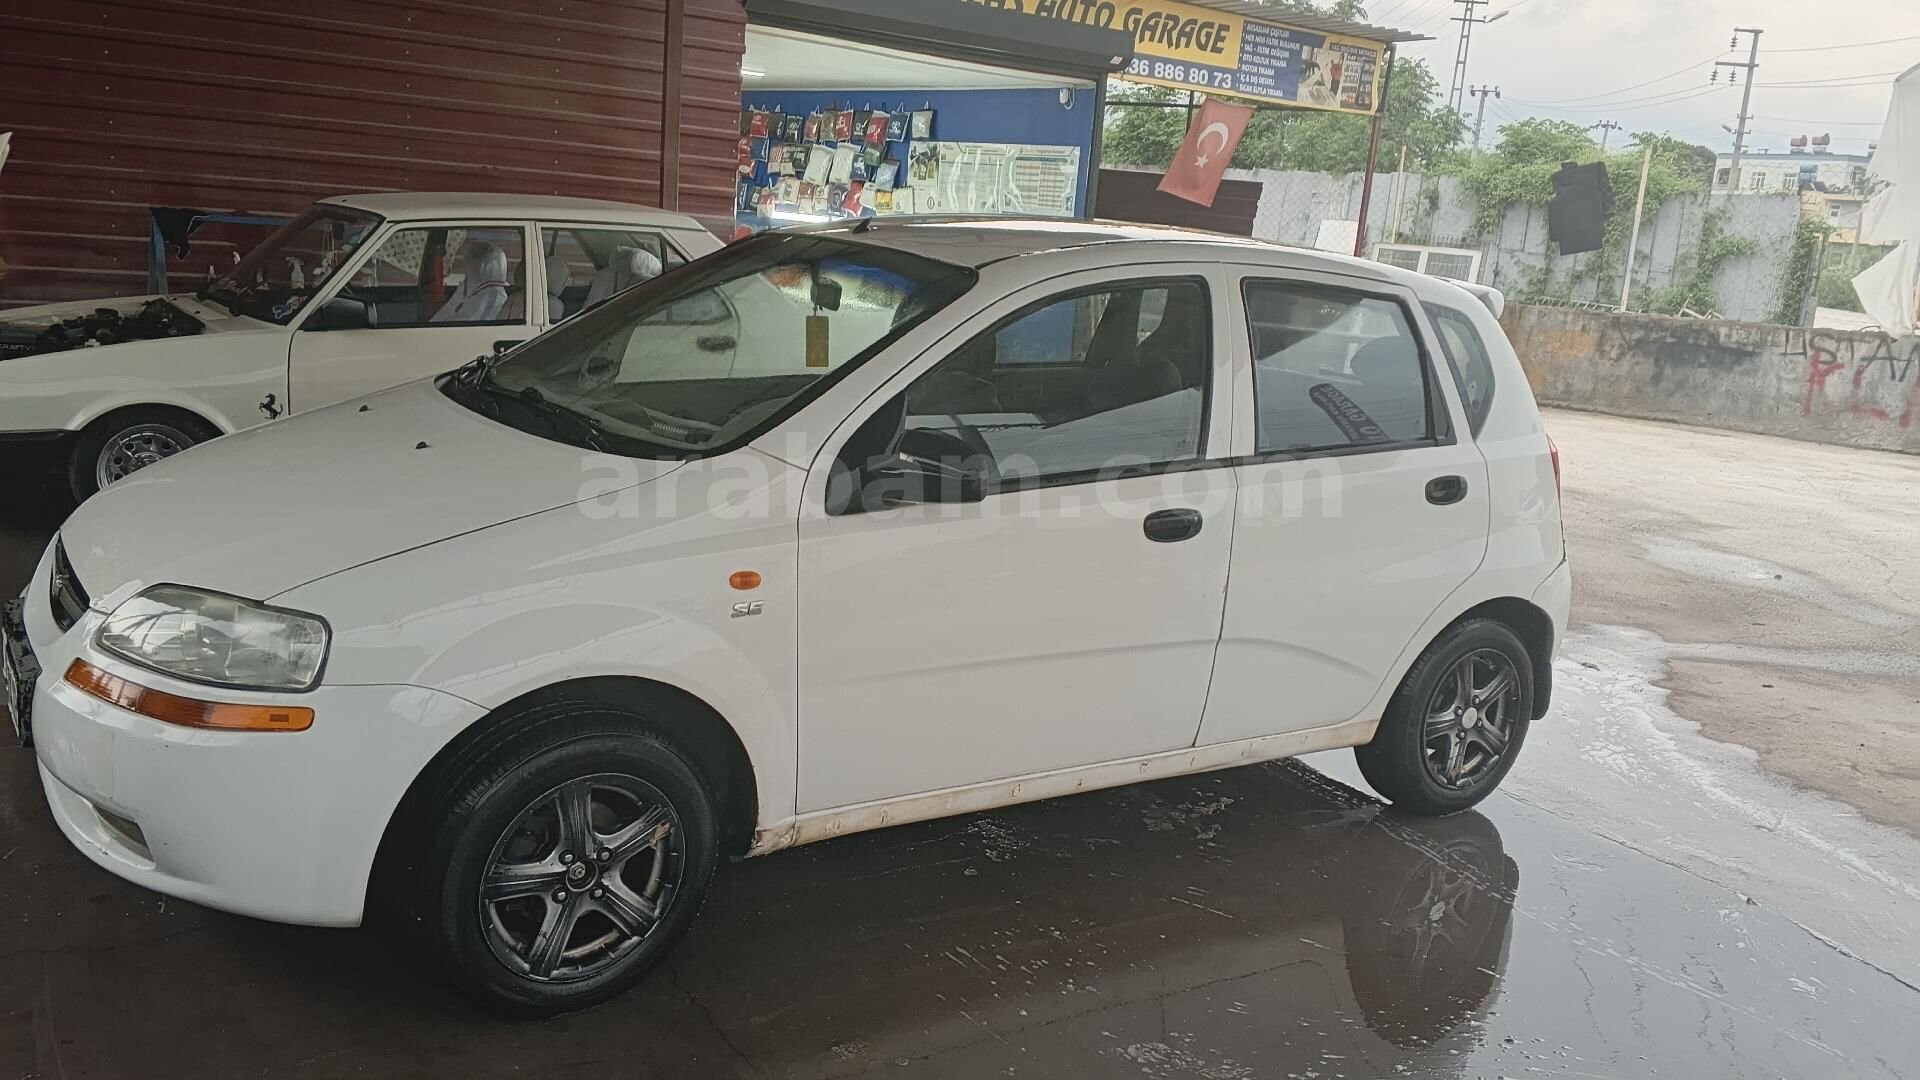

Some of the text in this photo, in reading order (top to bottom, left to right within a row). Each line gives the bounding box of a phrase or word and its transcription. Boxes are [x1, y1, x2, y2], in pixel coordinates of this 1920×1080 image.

[1123, 7, 1230, 54] GARAGE
[1154, 62, 1185, 81] 886
[1188, 67, 1208, 85] 80
[1213, 71, 1232, 89] 73
